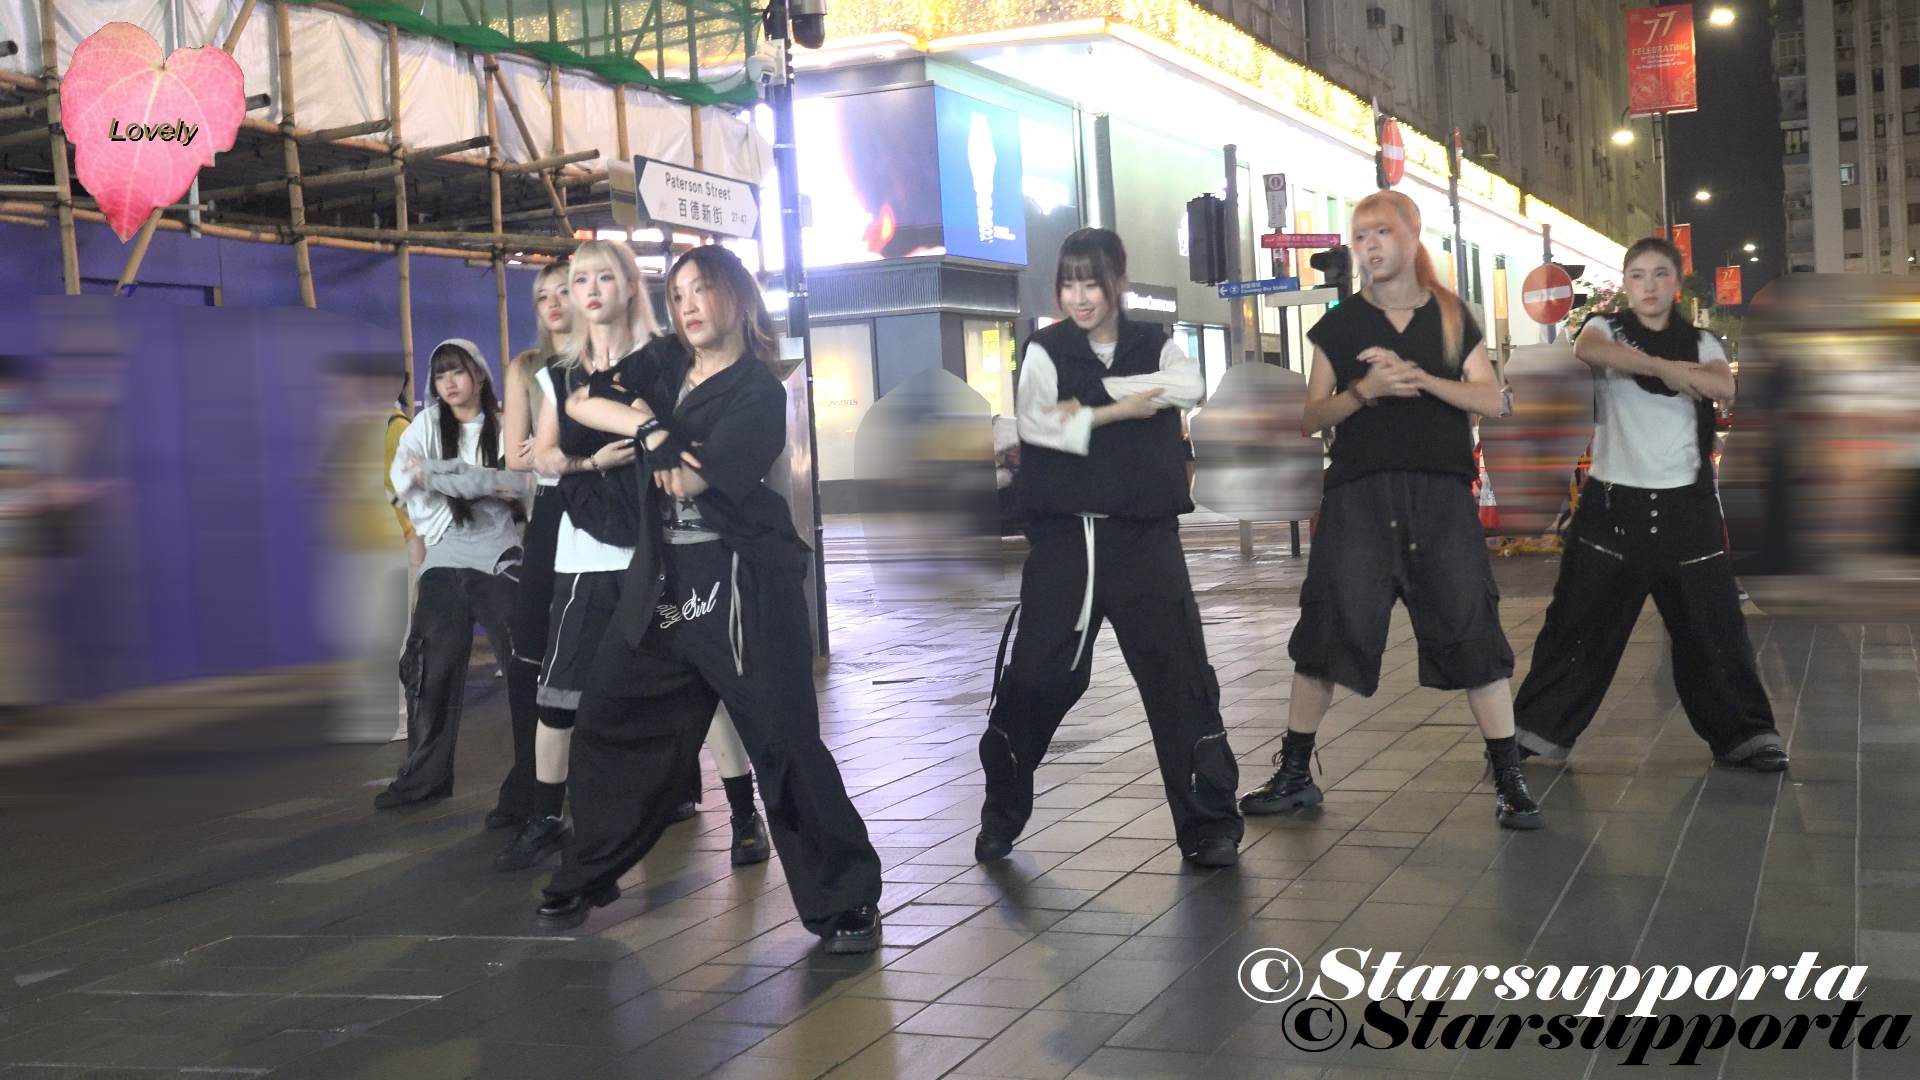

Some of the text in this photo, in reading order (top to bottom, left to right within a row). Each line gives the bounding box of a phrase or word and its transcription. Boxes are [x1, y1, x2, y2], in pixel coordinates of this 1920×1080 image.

[1643, 11, 1678, 45] 77
[1632, 43, 1690, 56] CELEBRATING
[665, 172, 731, 200] Paterson Street
[678, 198, 723, 225] 百德新街
